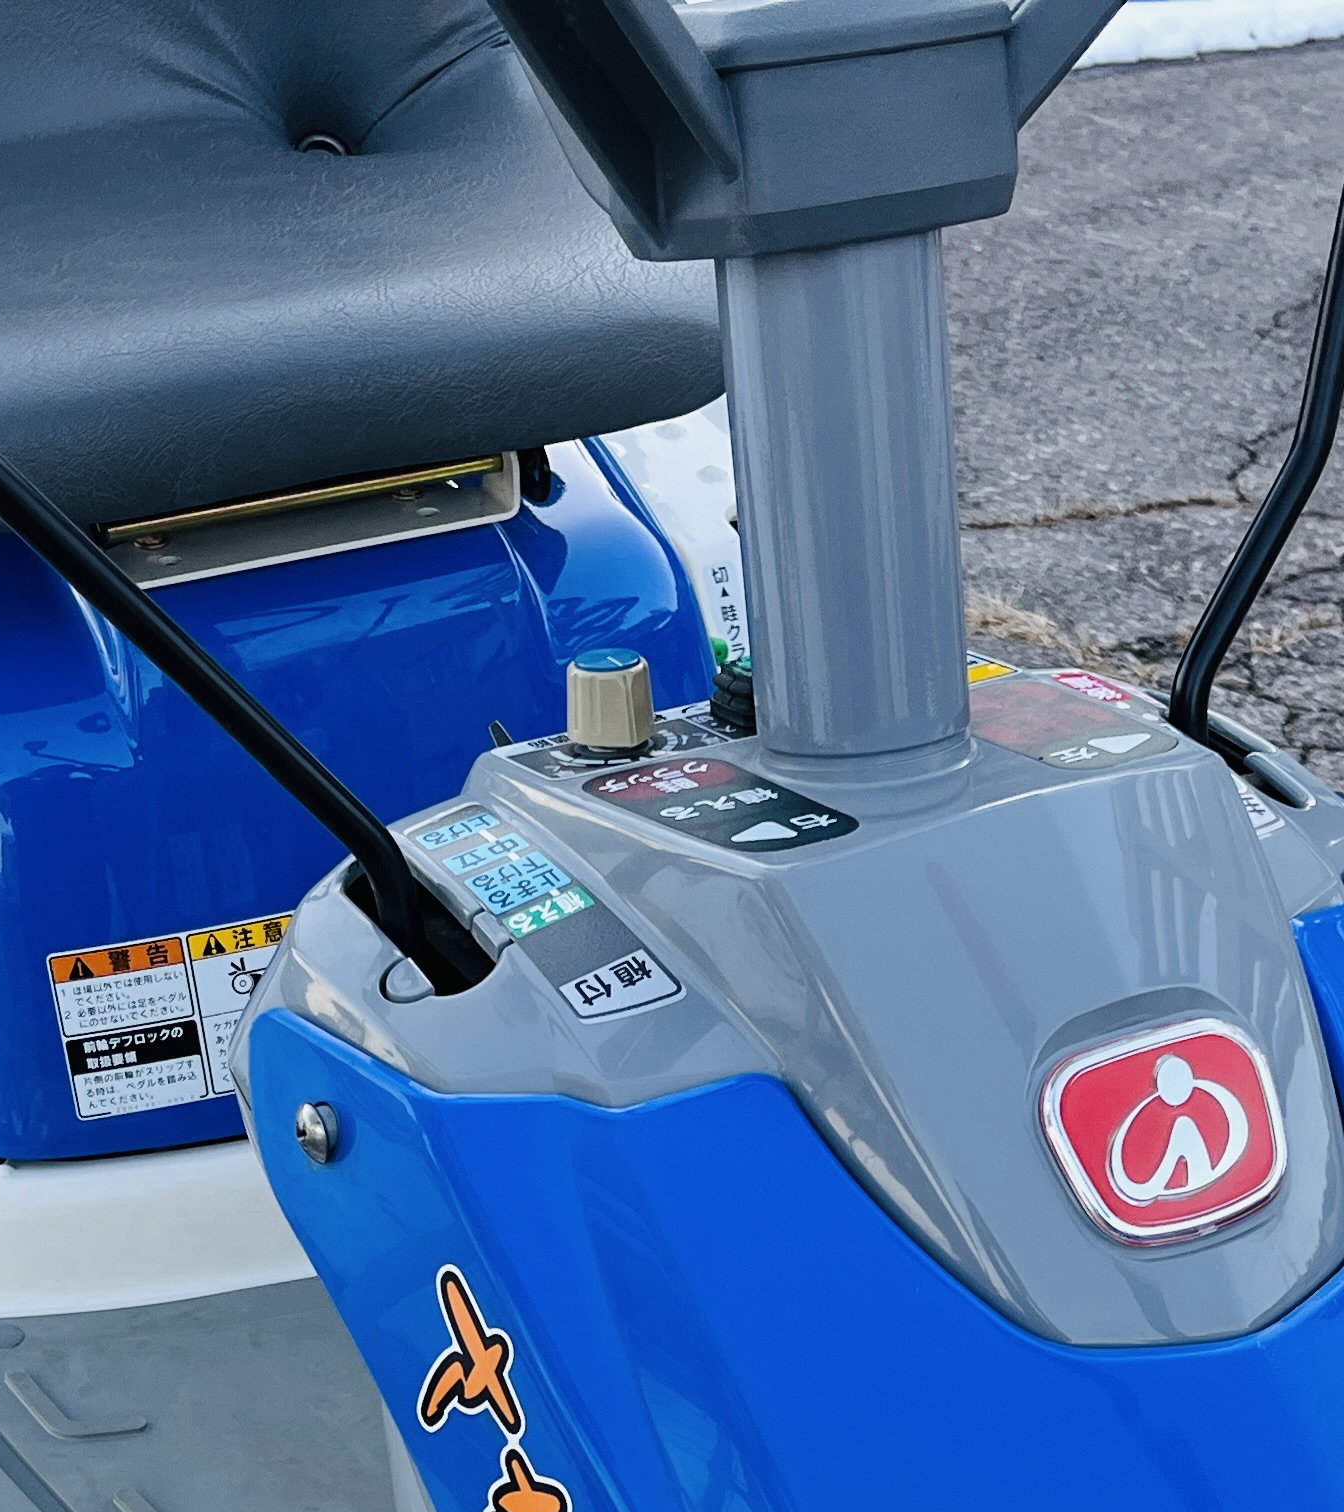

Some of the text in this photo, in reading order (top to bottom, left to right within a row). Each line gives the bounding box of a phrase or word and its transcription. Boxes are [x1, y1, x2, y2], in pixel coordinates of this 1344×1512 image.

[711, 566, 729, 584] 切
[599, 759, 709, 795] クラッチ
[659, 786, 780, 821] 植える
[421, 812, 500, 848] 上げる
[789, 812, 839, 831] 右
[451, 836, 519, 874] 中立
[470, 852, 552, 889] 下げる
[486, 867, 563, 908] 止まる
[507, 888, 587, 935] 植える
[232, 921, 284, 950] 注意
[108, 943, 169, 972] 警告
[573, 953, 655, 1008] 植付
[64, 1010, 72, 1020] 2
[83, 1026, 184, 1054] 前輪デフロックの
